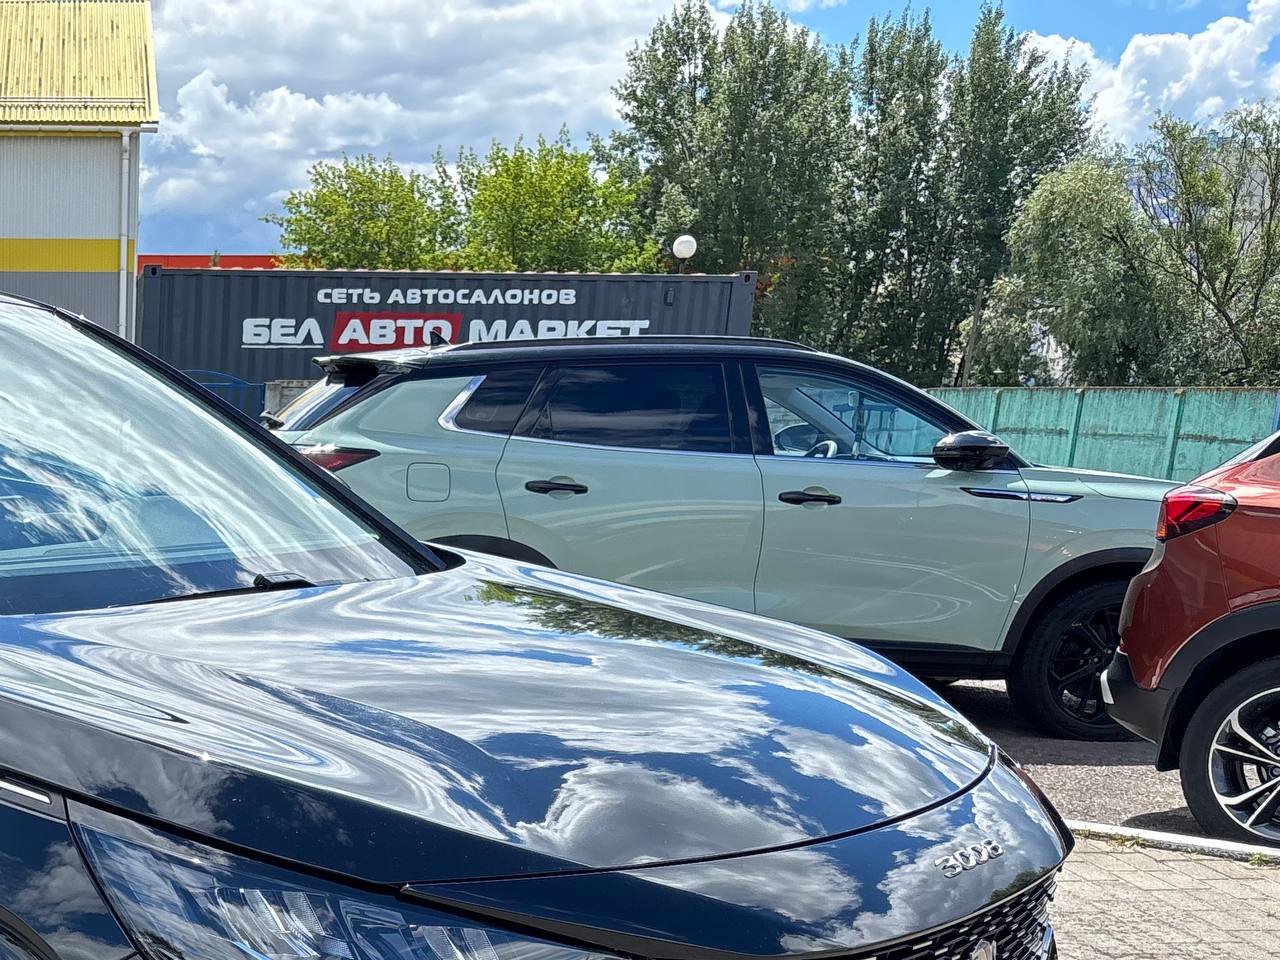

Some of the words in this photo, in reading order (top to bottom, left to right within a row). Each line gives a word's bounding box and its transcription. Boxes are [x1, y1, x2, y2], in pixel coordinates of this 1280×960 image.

[317, 288, 381, 304] СЕТЬ
[387, 288, 577, 305] АВТОСАЛОНОВ
[242, 317, 324, 345] БЕЛ
[338, 318, 453, 345] АВТО
[469, 319, 650, 342] МАРКЕТ
[935, 838, 1005, 879] 3008
